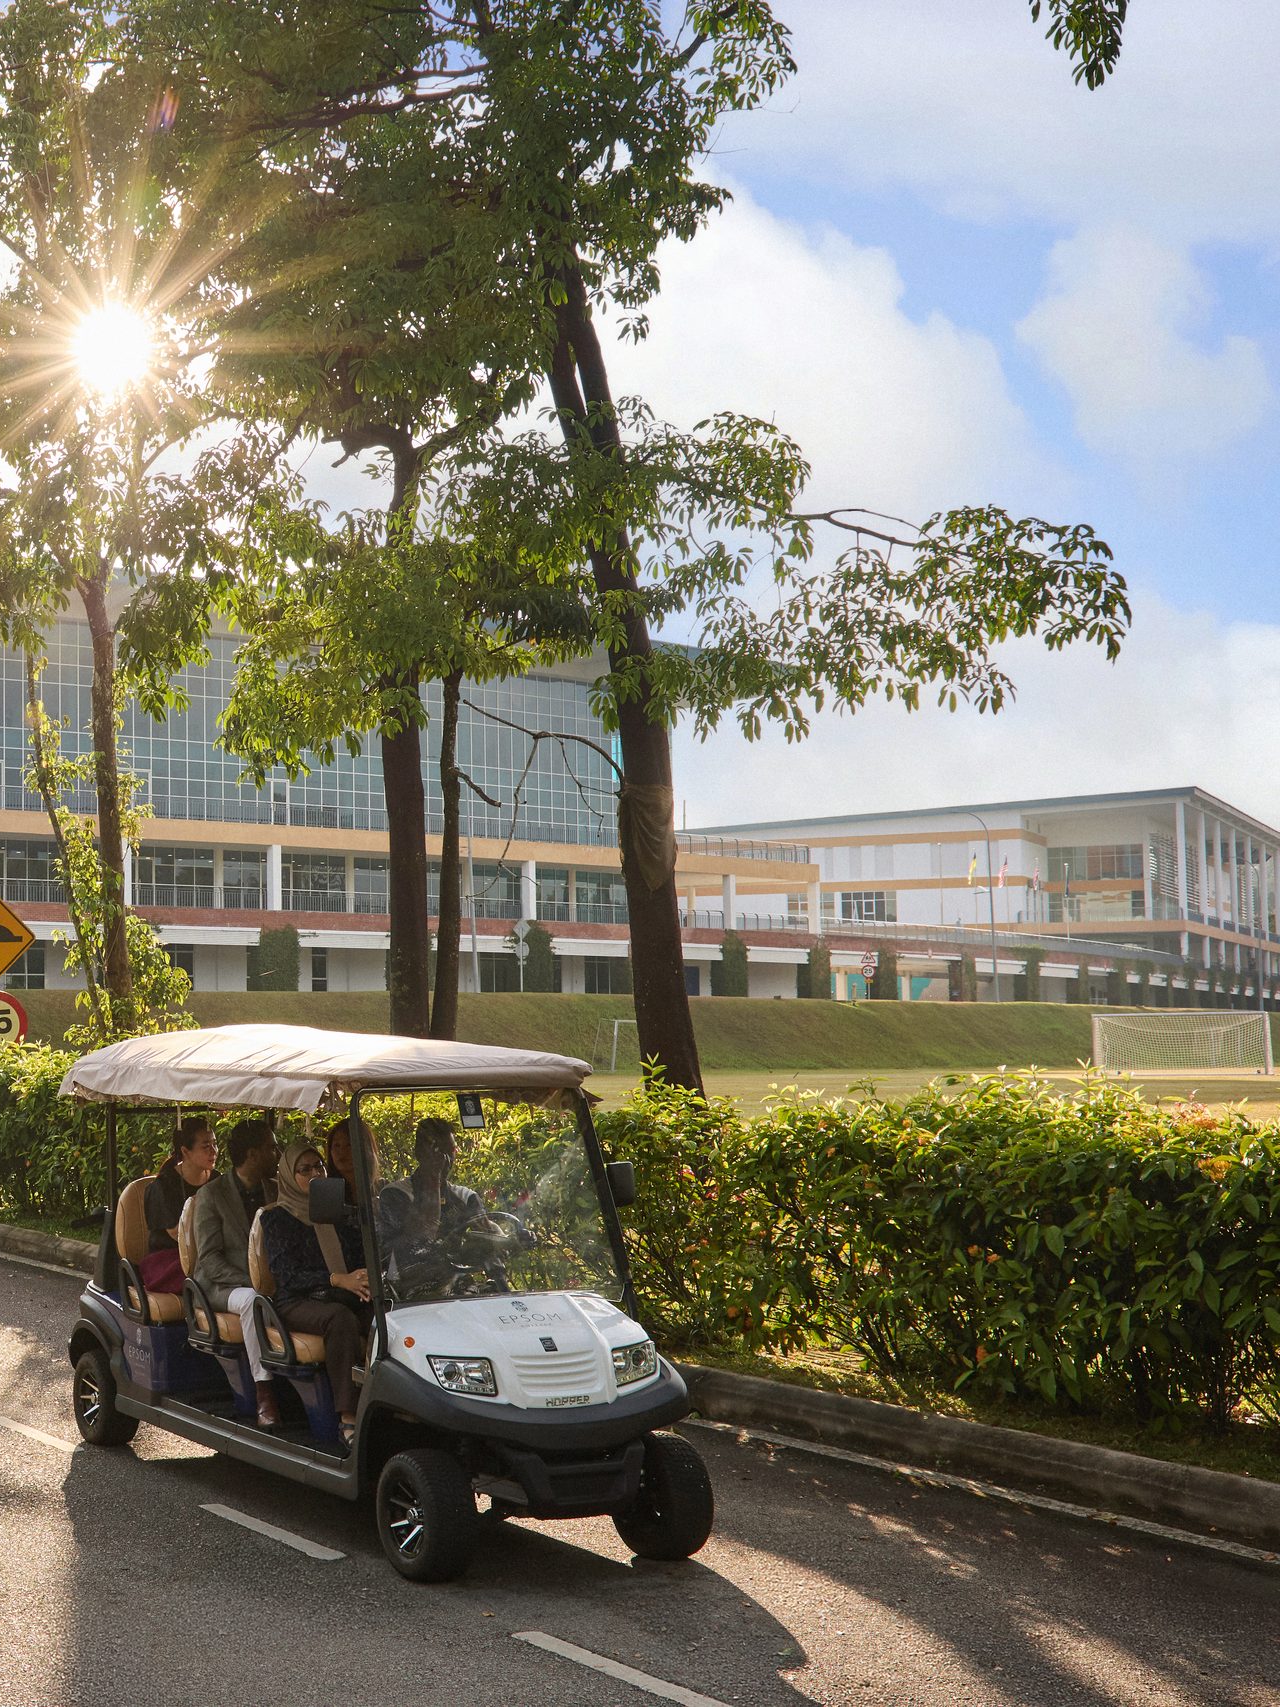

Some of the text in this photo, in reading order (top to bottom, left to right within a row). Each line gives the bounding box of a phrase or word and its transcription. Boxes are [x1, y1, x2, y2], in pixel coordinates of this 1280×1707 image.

[498, 1312, 562, 1325] EPSOM
[128, 1345, 151, 1364] EPSOM
[544, 1395, 591, 1408] HOPPER
